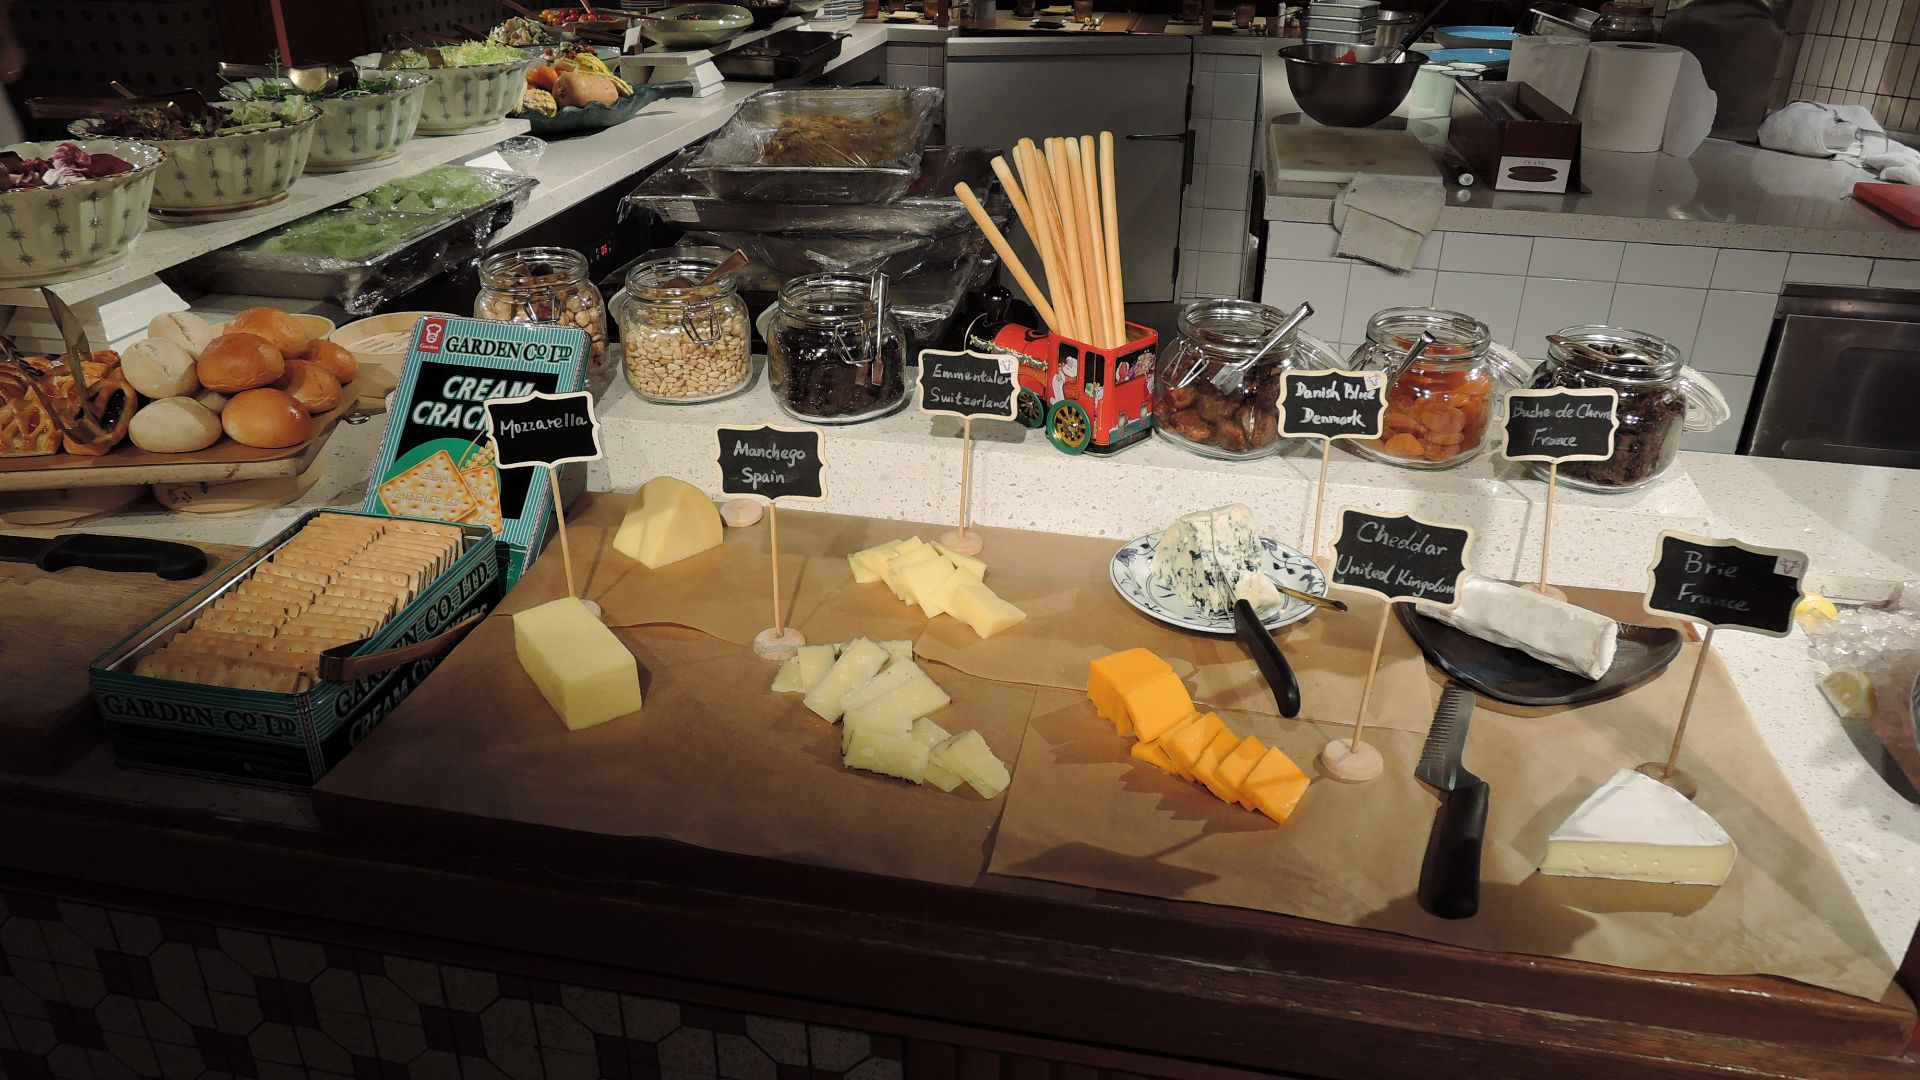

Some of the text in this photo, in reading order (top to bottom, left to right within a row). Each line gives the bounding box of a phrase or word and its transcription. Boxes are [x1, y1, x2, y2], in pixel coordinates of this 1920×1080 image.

[446, 336, 522, 360] GARDEN
[932, 363, 1012, 385] Emmentaler
[442, 375, 536, 400] CREAM
[930, 387, 1011, 410] Switzerland
[1295, 380, 1376, 402] Danish Blue
[1299, 407, 1366, 427] Denmark
[1555, 402, 1574, 418] de
[500, 413, 588, 438] Mozzarella
[1531, 427, 1578, 447] France
[733, 440, 806, 467] Manchego
[742, 467, 785, 490] Spain
[1356, 521, 1447, 555] Cheddar
[1335, 554, 1455, 597] United Kingdom
[1684, 551, 1738, 578] Brie
[1677, 583, 1750, 611] France
[103, 694, 216, 729] GARDEN
